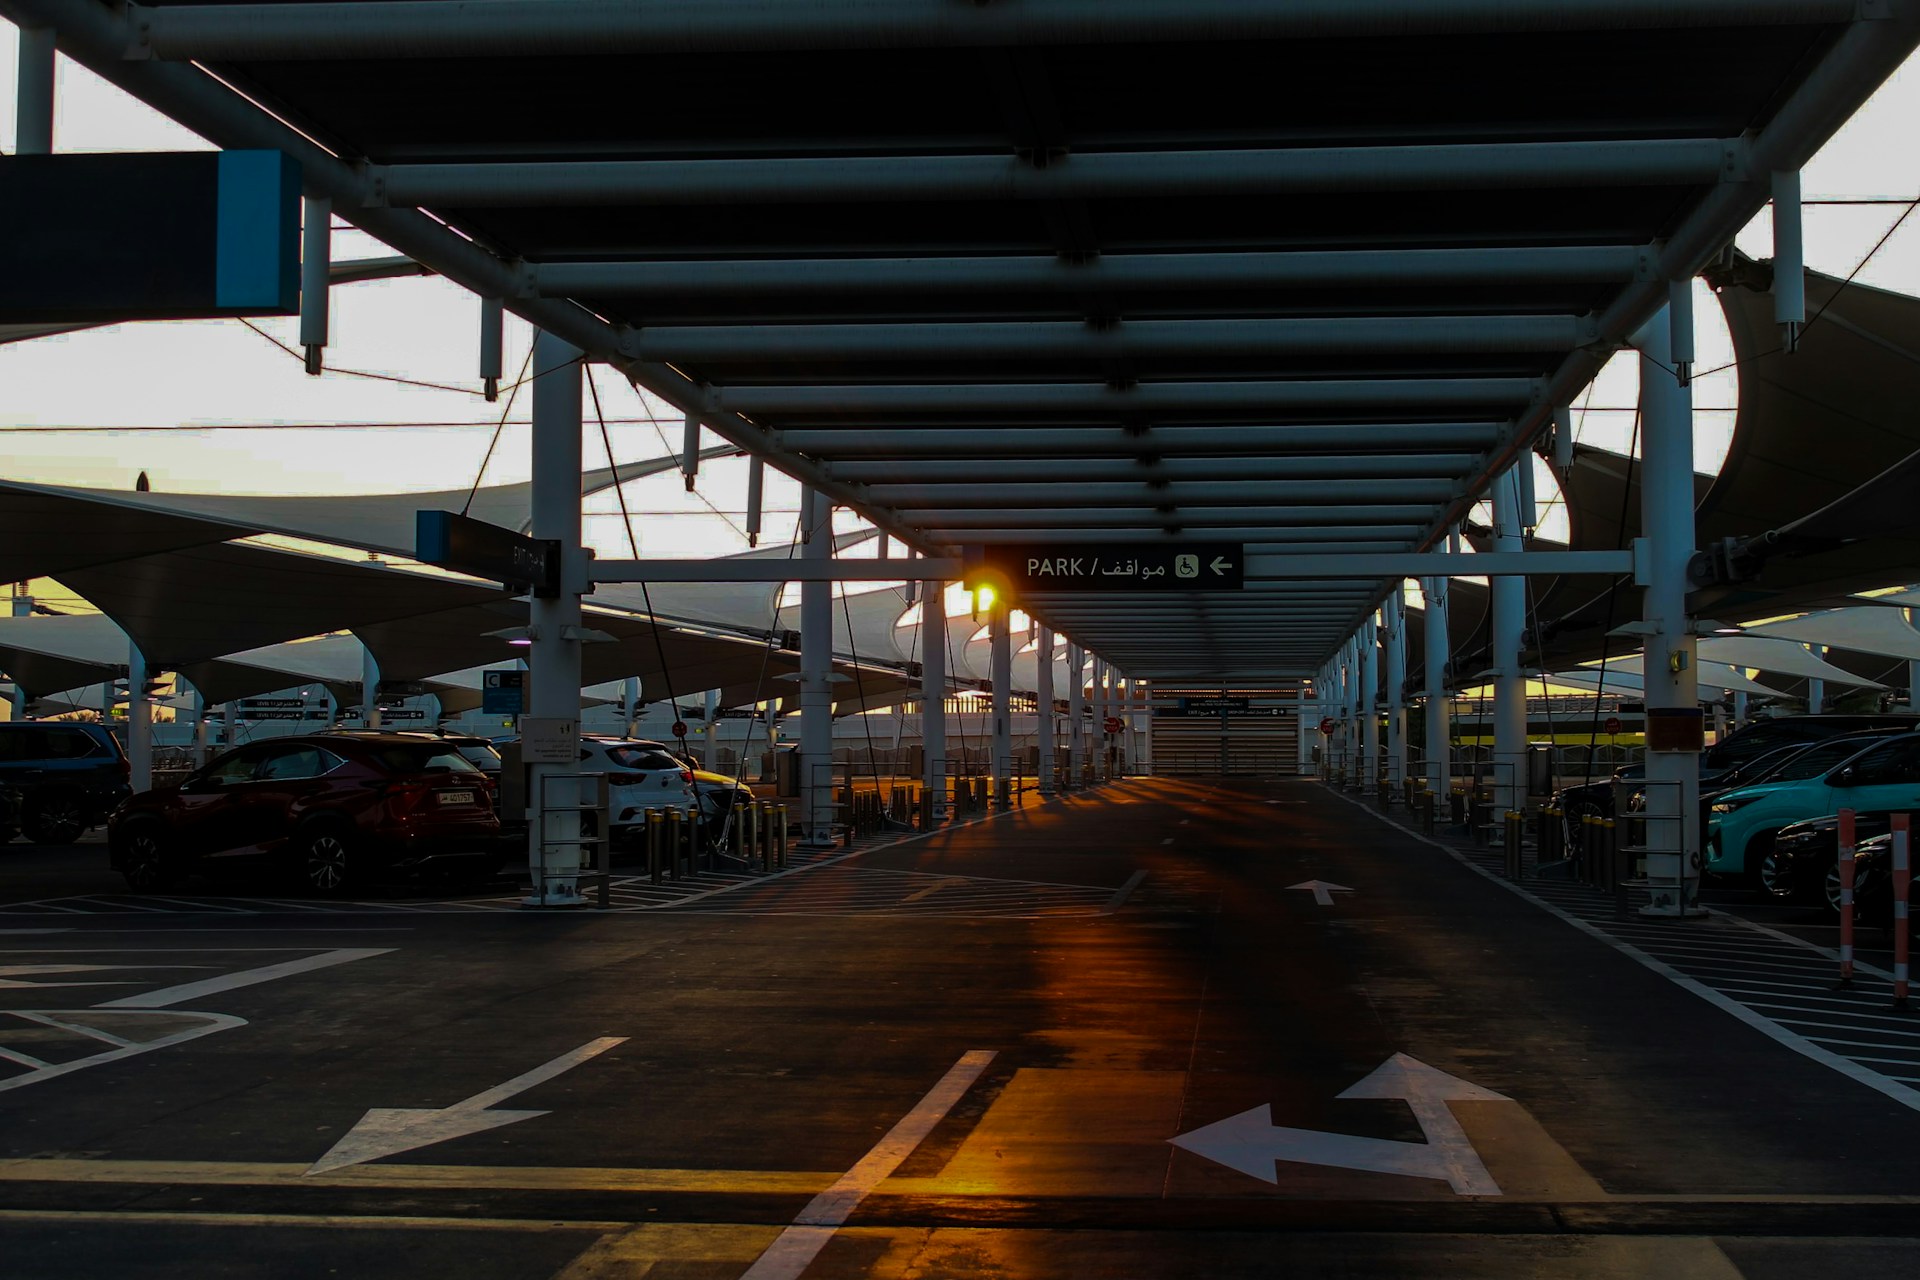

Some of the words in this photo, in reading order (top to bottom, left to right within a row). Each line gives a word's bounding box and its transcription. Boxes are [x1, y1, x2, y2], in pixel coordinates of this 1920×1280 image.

[1027, 558, 1083, 576] PARK
[1090, 557, 1098, 576] /
[1101, 559, 1166, 580] مواقف
[489, 674, 498, 686] C
